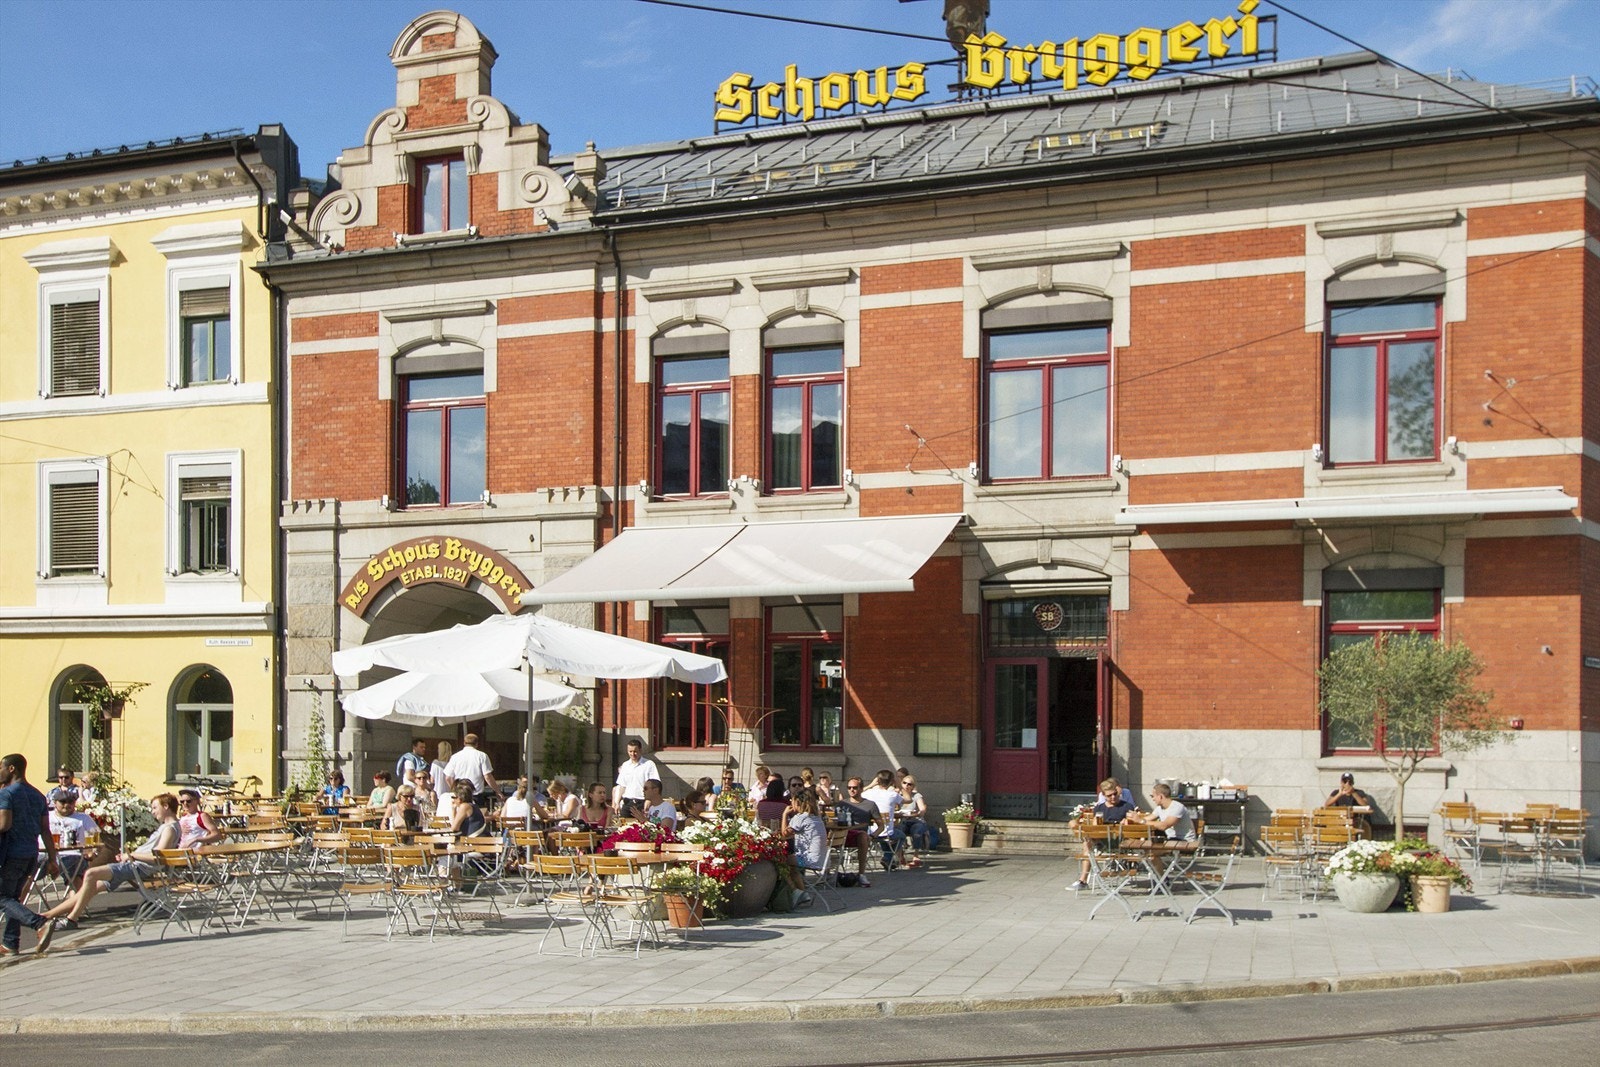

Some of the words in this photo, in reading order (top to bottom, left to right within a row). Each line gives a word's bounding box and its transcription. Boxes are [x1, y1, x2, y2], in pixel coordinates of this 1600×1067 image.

[714, 63, 926, 123] Schous
[963, 0, 1260, 91] Bryggeri
[367, 542, 440, 582] Schous
[1041, 612, 1054, 621] SB
